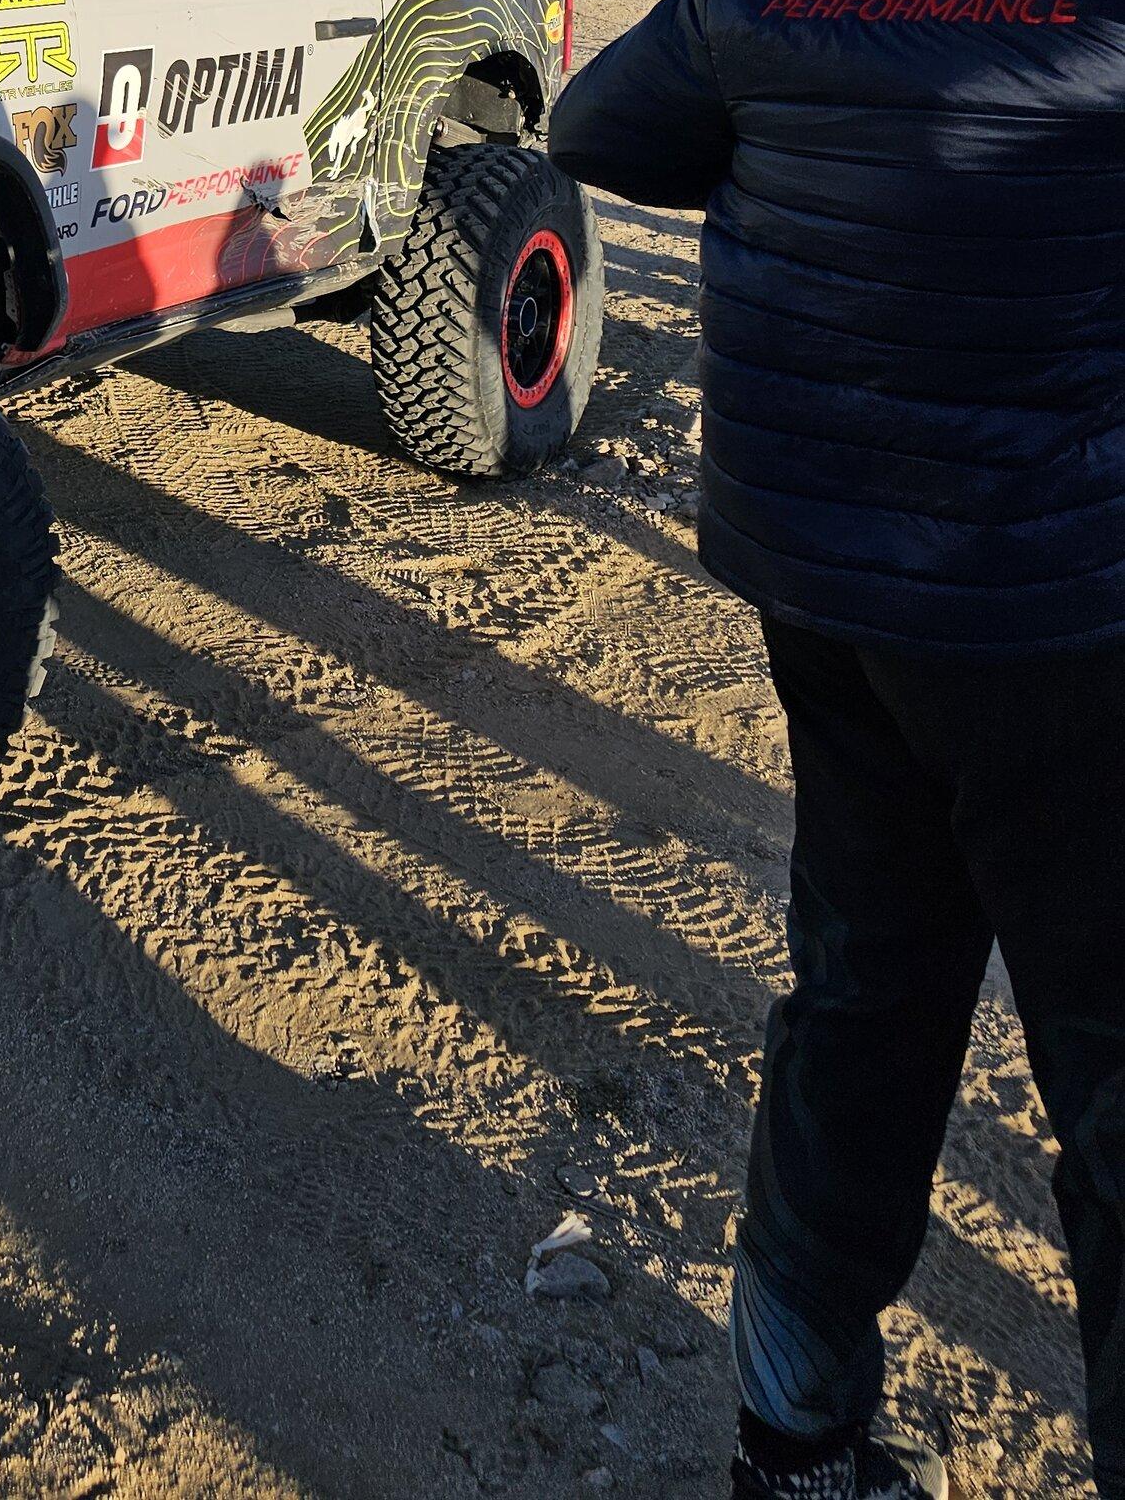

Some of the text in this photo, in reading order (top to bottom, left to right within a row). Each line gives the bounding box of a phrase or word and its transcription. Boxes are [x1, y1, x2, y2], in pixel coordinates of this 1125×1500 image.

[18, 79, 74, 99] VEHICLES
[157, 45, 305, 139] OPTIMA
[12, 103, 78, 177] FOX
[91, 152, 305, 228] FORD PERFORMANCE
